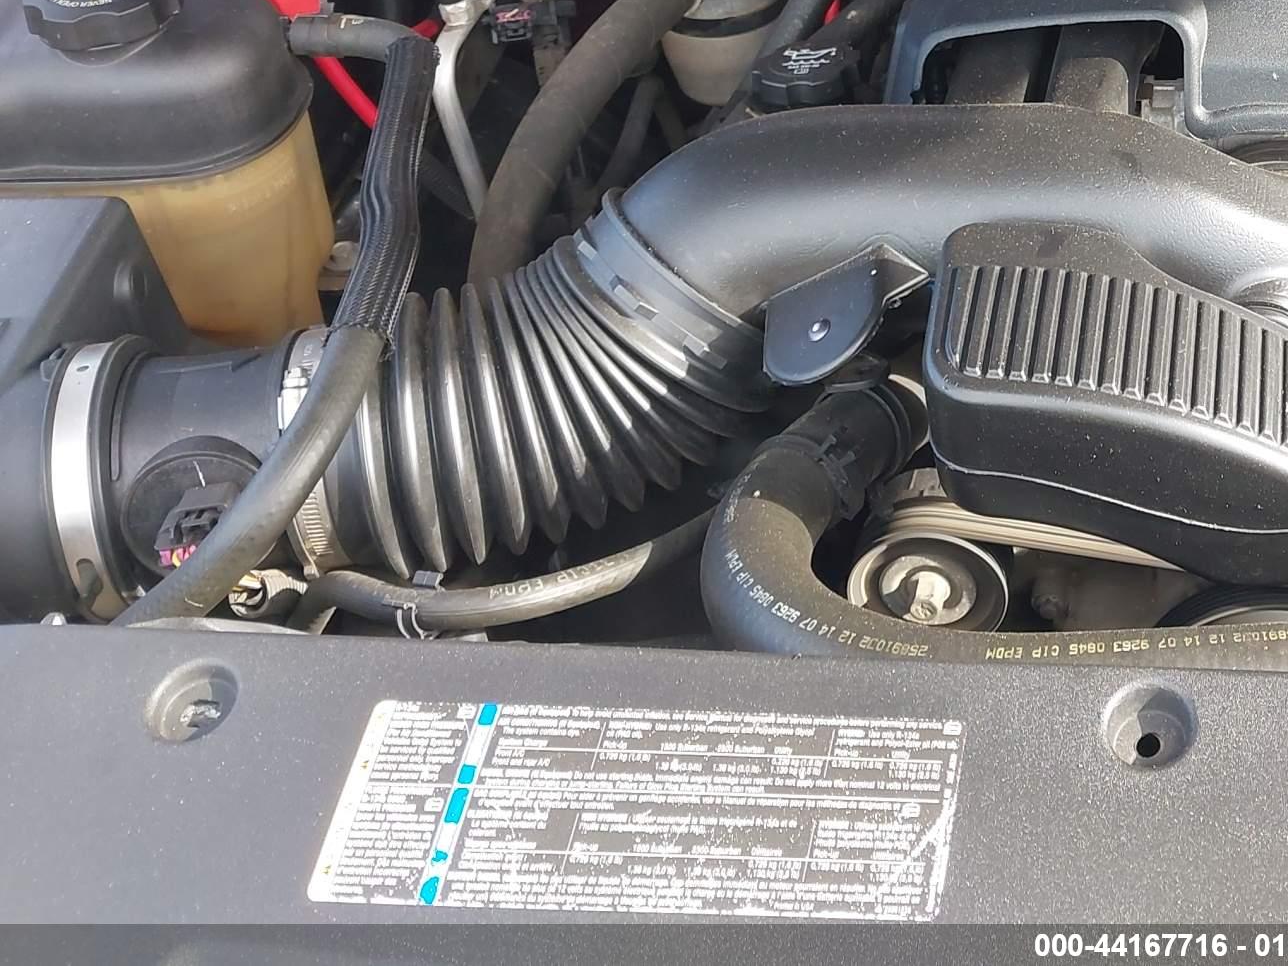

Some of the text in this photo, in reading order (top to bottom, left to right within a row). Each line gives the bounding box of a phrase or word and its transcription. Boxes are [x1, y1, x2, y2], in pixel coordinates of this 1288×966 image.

[723, 548, 745, 575] EPDM
[733, 569, 755, 588] CIP
[770, 601, 801, 622] 9263
[798, 617, 818, 631] 07
[818, 623, 836, 639] 14
[837, 629, 857, 646] 12
[1157, 635, 1176, 650] 07
[1183, 633, 1200, 648] 14
[1208, 632, 1225, 645] 12
[985, 645, 1023, 660] EPDM
[1031, 643, 1060, 658] CIP
[1112, 638, 1149, 653] 9263
